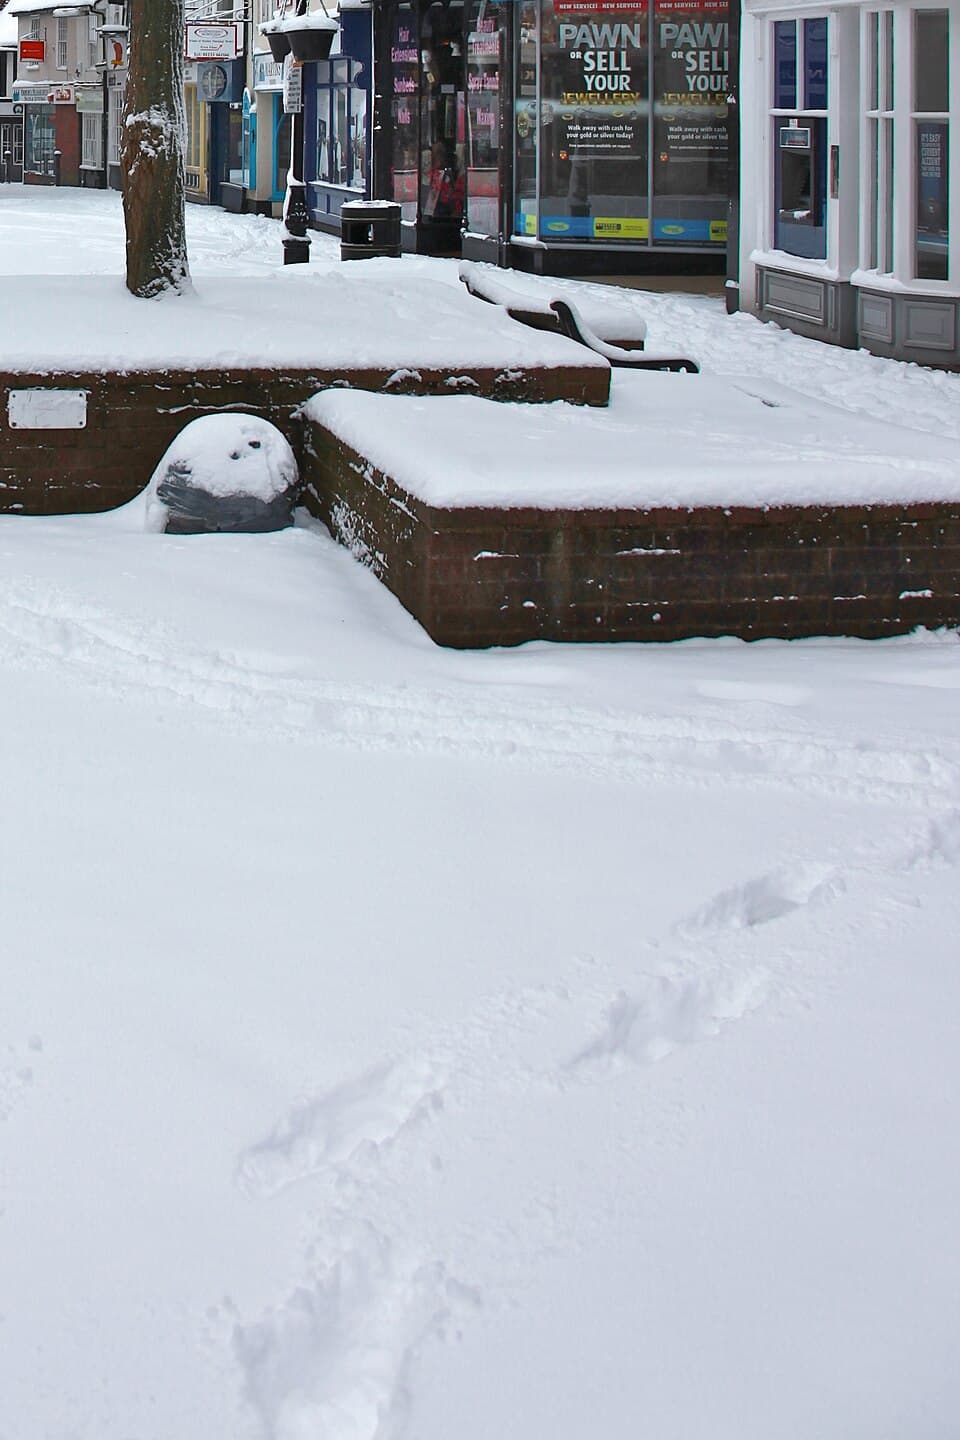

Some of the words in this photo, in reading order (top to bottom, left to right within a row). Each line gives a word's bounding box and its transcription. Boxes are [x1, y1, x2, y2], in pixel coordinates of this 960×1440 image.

[559, 23, 641, 49] PAWN
[660, 23, 728, 49] PAW
[569, 51, 582, 59] OR
[583, 50, 631, 72] SELL
[671, 51, 684, 59] OR
[583, 74, 631, 91] YOUR
[561, 92, 640, 106] JEWELLERY
[616, 132, 634, 140] today!
